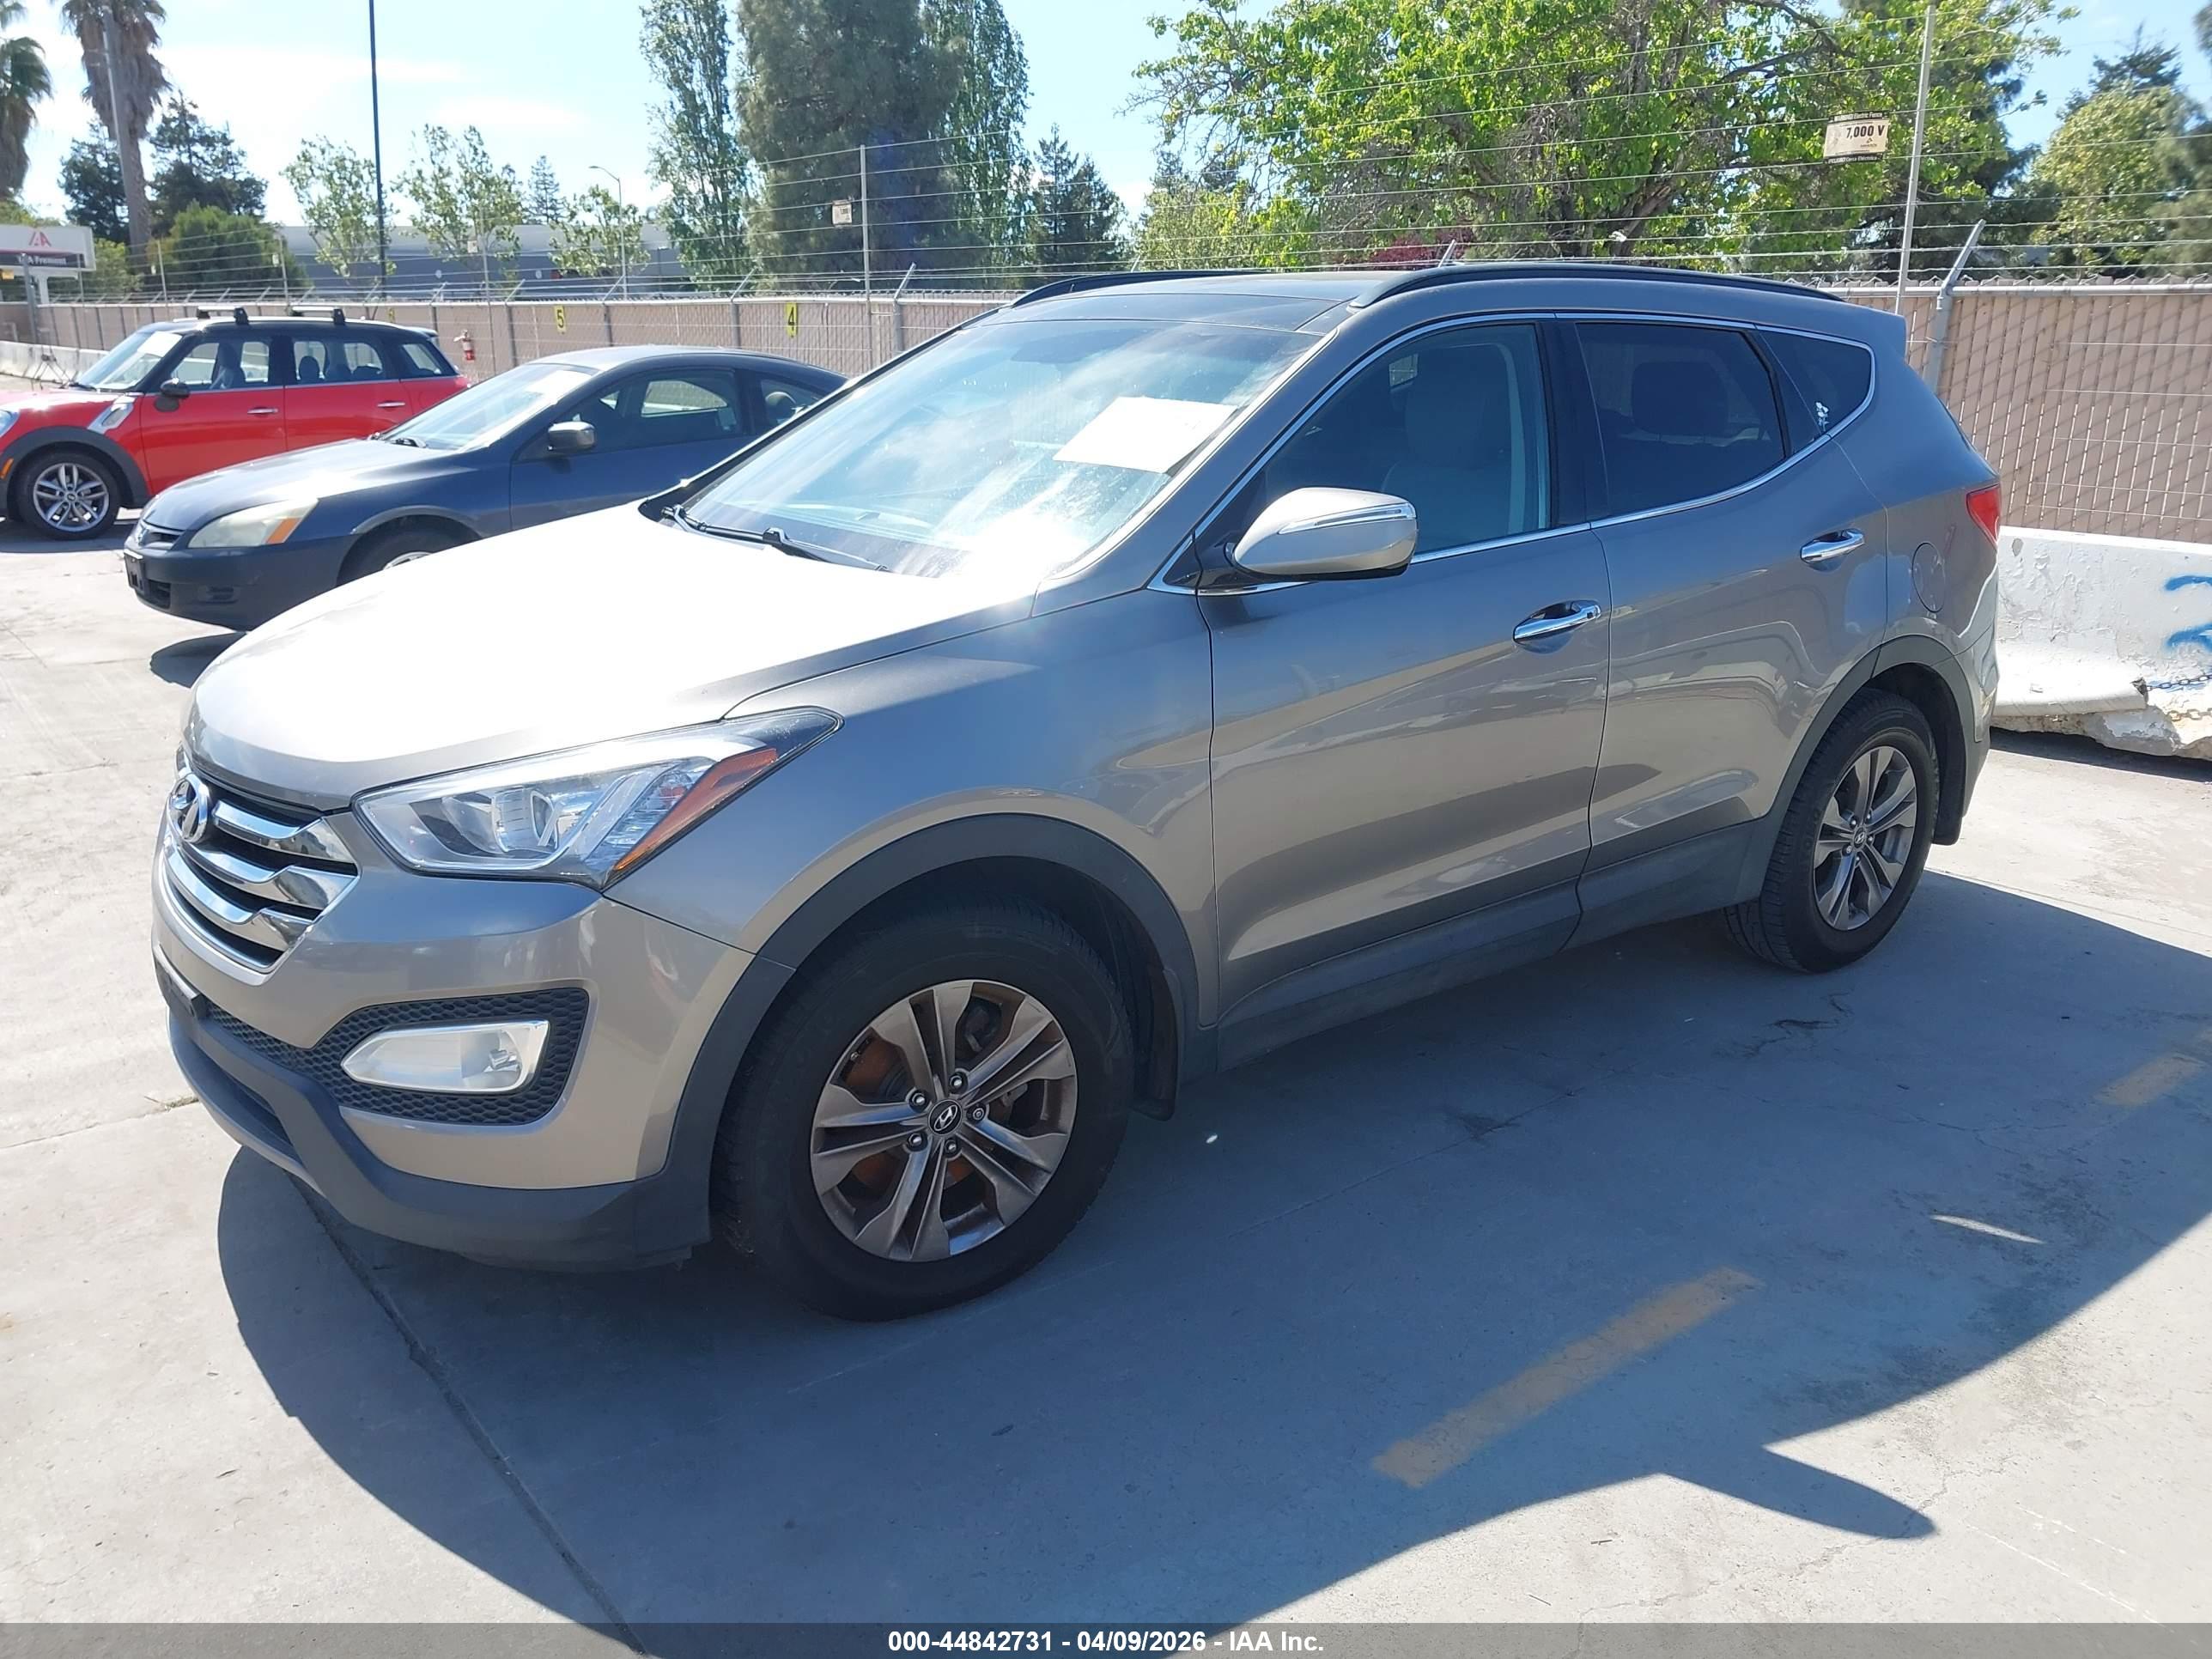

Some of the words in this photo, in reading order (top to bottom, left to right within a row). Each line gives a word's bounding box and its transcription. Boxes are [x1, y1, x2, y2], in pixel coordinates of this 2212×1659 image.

[1846, 125, 1874, 139] 7,000
[1878, 125, 1885, 137] V
[556, 308, 564, 329] 5
[787, 306, 795, 332] 4
